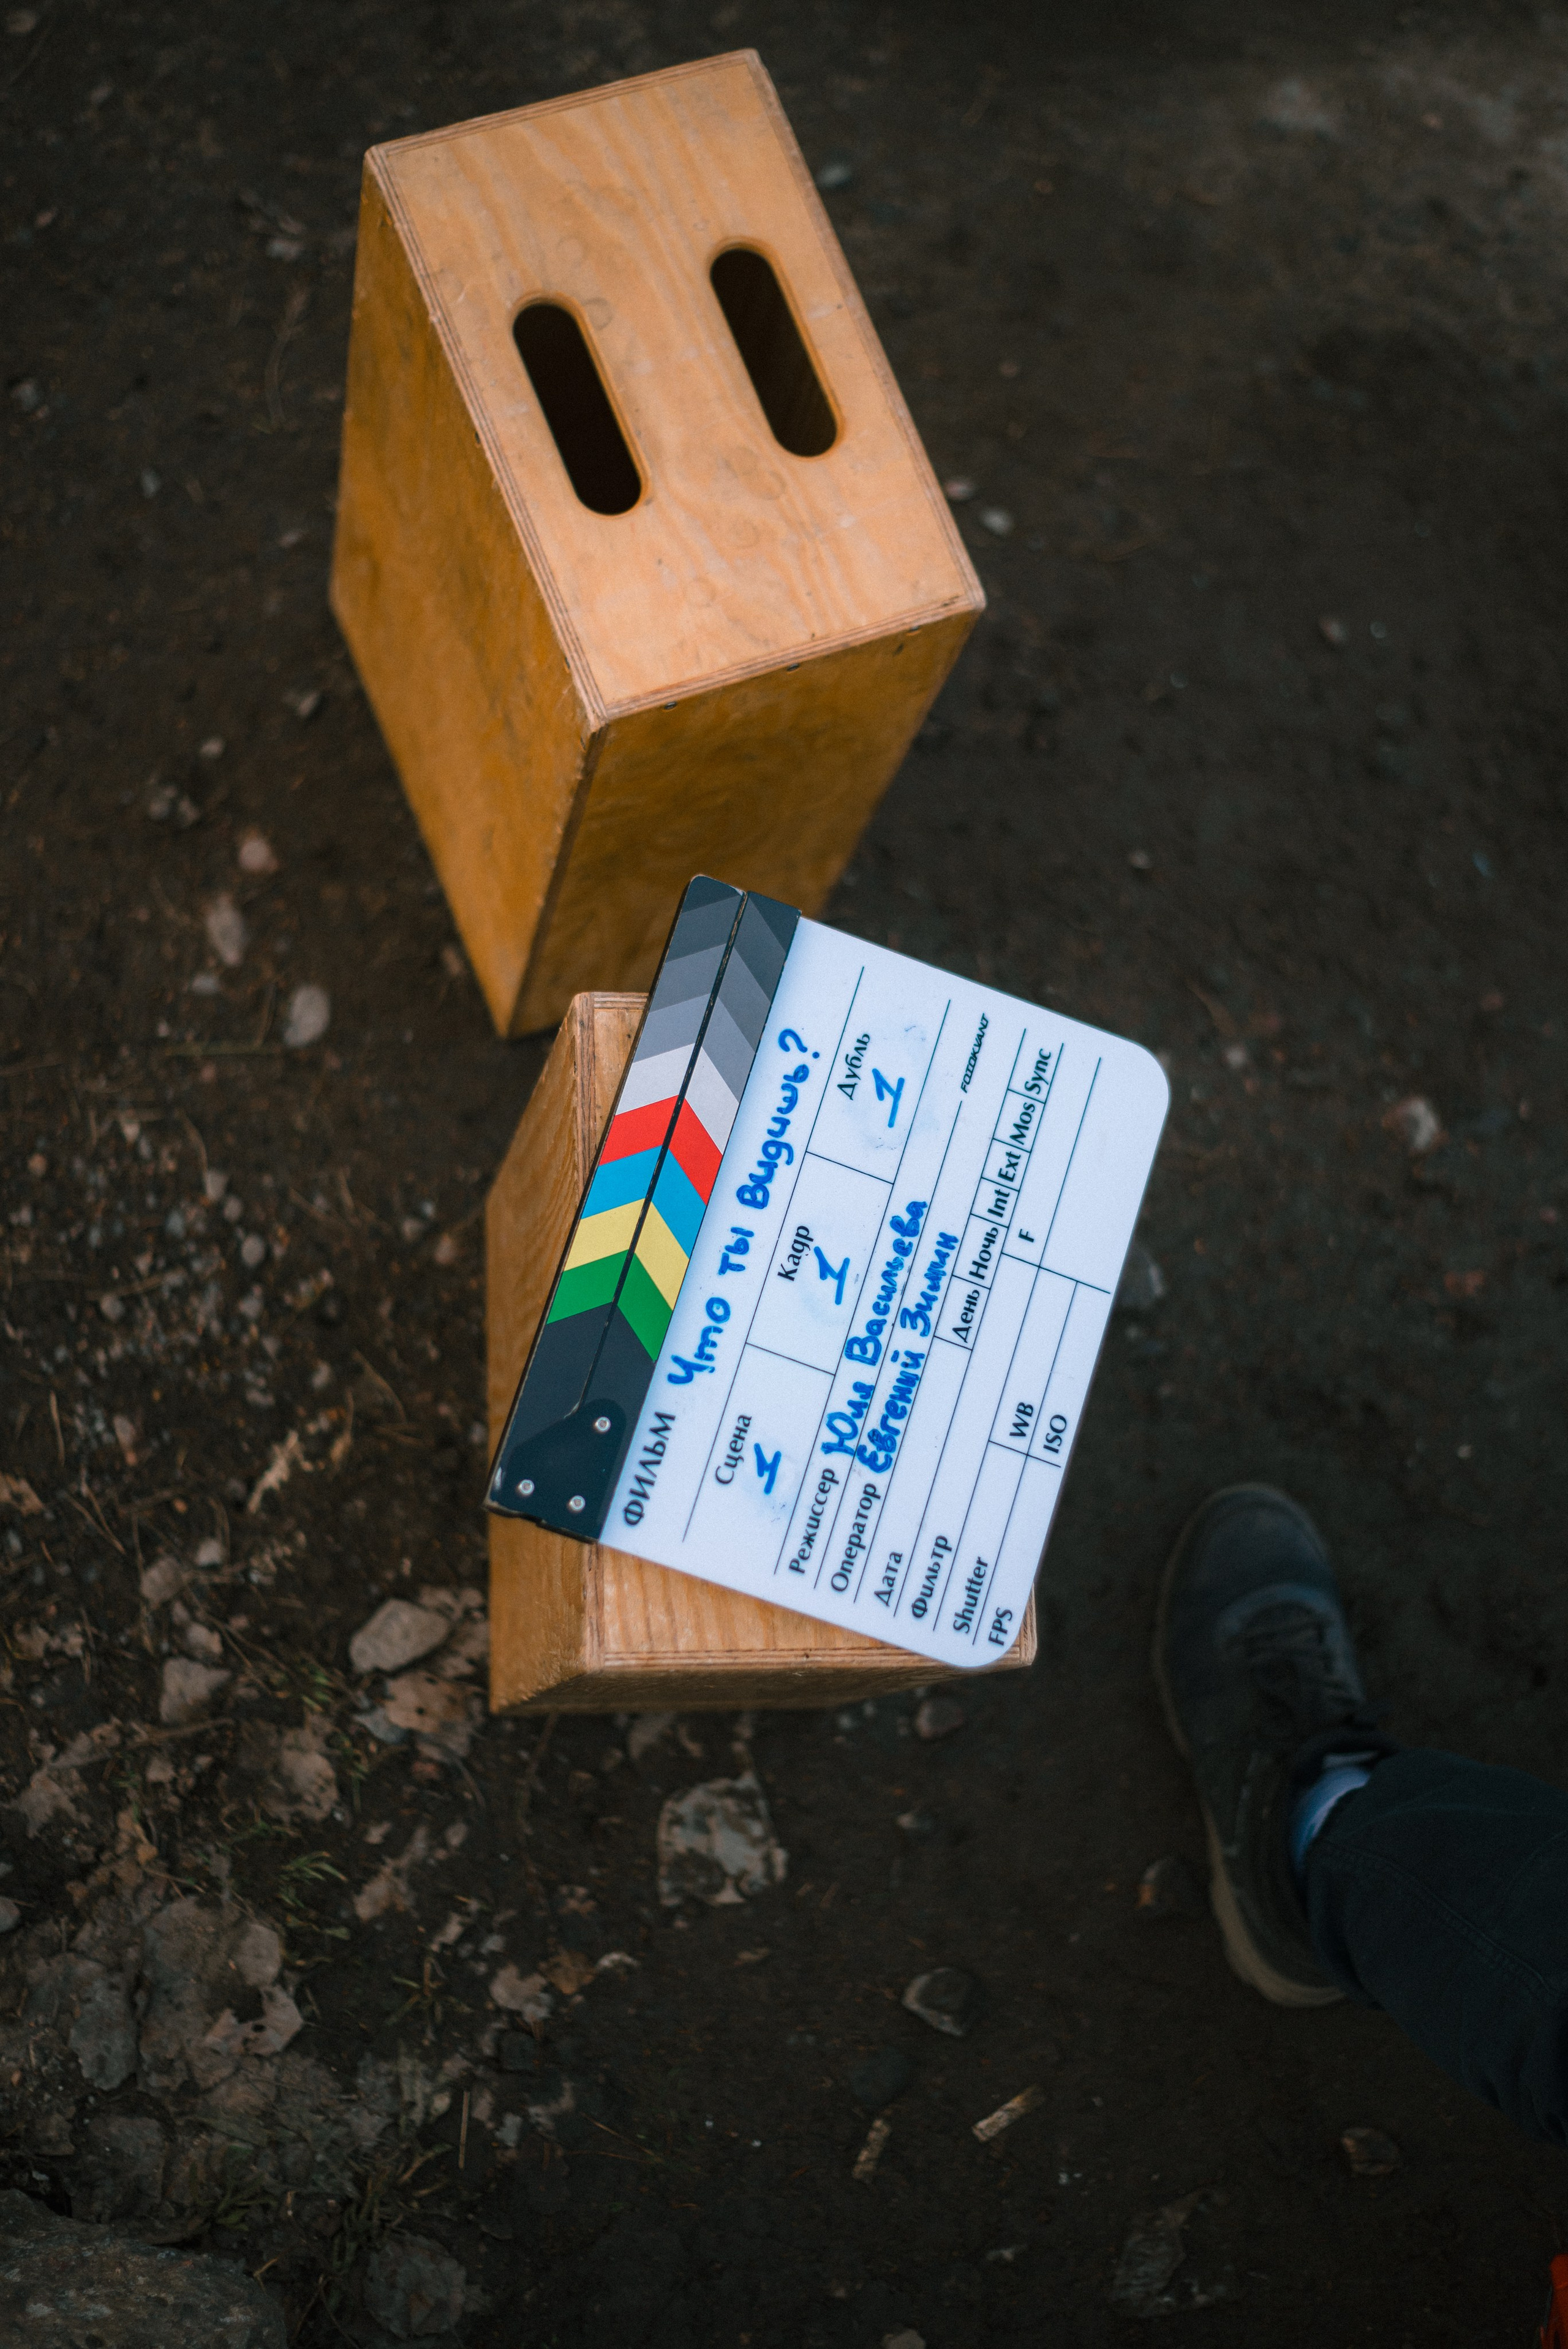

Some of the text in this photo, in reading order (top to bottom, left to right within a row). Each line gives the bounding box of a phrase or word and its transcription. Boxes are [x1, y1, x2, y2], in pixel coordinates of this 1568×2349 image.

[836, 1032, 871, 1101] Дубль
[1024, 1048, 1052, 1095] Sync
[872, 1068, 905, 1128] 1
[1009, 1102, 1036, 1145] Mos
[998, 1150, 1022, 1183] Ext
[986, 1188, 1010, 1219] Int
[777, 1224, 814, 1282] Кадр
[968, 1226, 999, 1280] Ночь
[1018, 1228, 1035, 1243] F
[813, 1245, 850, 1305] 1
[666, 1296, 731, 1386] Что
[717, 1226, 755, 1276] ты
[821, 1201, 929, 1457] Юля Васильева
[952, 1289, 981, 1344] День
[856, 1232, 960, 1474] Евгений Зимин
[1008, 1401, 1034, 1438] WB
[1042, 1414, 1068, 1455] ISO
[623, 1411, 676, 1526] ФИЛЬМ
[714, 1414, 753, 1485] Сцена
[753, 1442, 782, 1495] 1
[788, 1468, 840, 1575] Режиссер
[831, 1482, 882, 1592] Оператор
[873, 1552, 903, 1607] Дата
[911, 1534, 953, 1619] Фильтр
[952, 1556, 989, 1634] Shutter
[987, 1607, 1013, 1646] FPS
